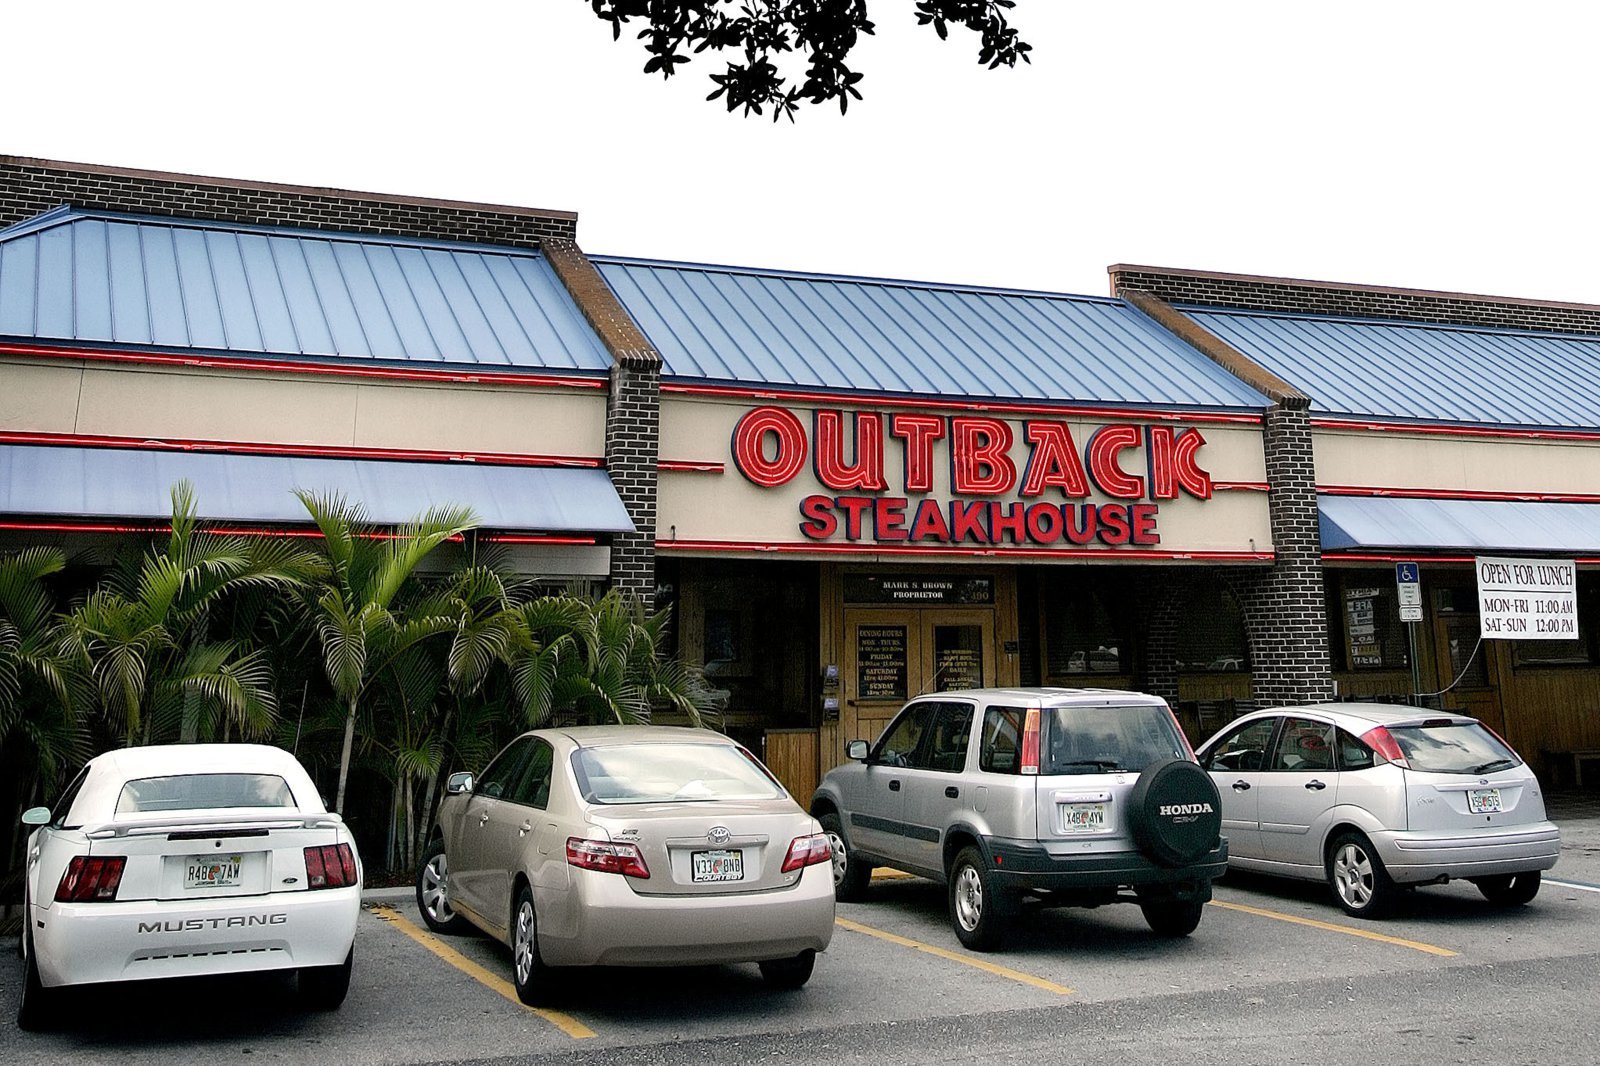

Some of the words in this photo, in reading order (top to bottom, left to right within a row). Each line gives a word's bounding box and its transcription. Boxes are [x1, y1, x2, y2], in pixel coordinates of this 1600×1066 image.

[732, 406, 1211, 500] OUTBACK
[799, 495, 1160, 545] STEAKHOUSE
[1481, 563, 1512, 584] OPEN
[1513, 564, 1537, 585] FOR
[1537, 565, 1573, 586] LUNCH
[893, 591, 944, 599] PROPRIETOR
[1484, 598, 1529, 613] MON-FRI
[1535, 600, 1559, 613] 11:00
[1560, 600, 1573, 613] AM
[1485, 617, 1527, 632] SAT-SUN
[1536, 618, 1559, 632] 12:00
[1561, 618, 1574, 632] PM
[1159, 803, 1213, 816] HONDA
[138, 913, 288, 934] MUSTANG
